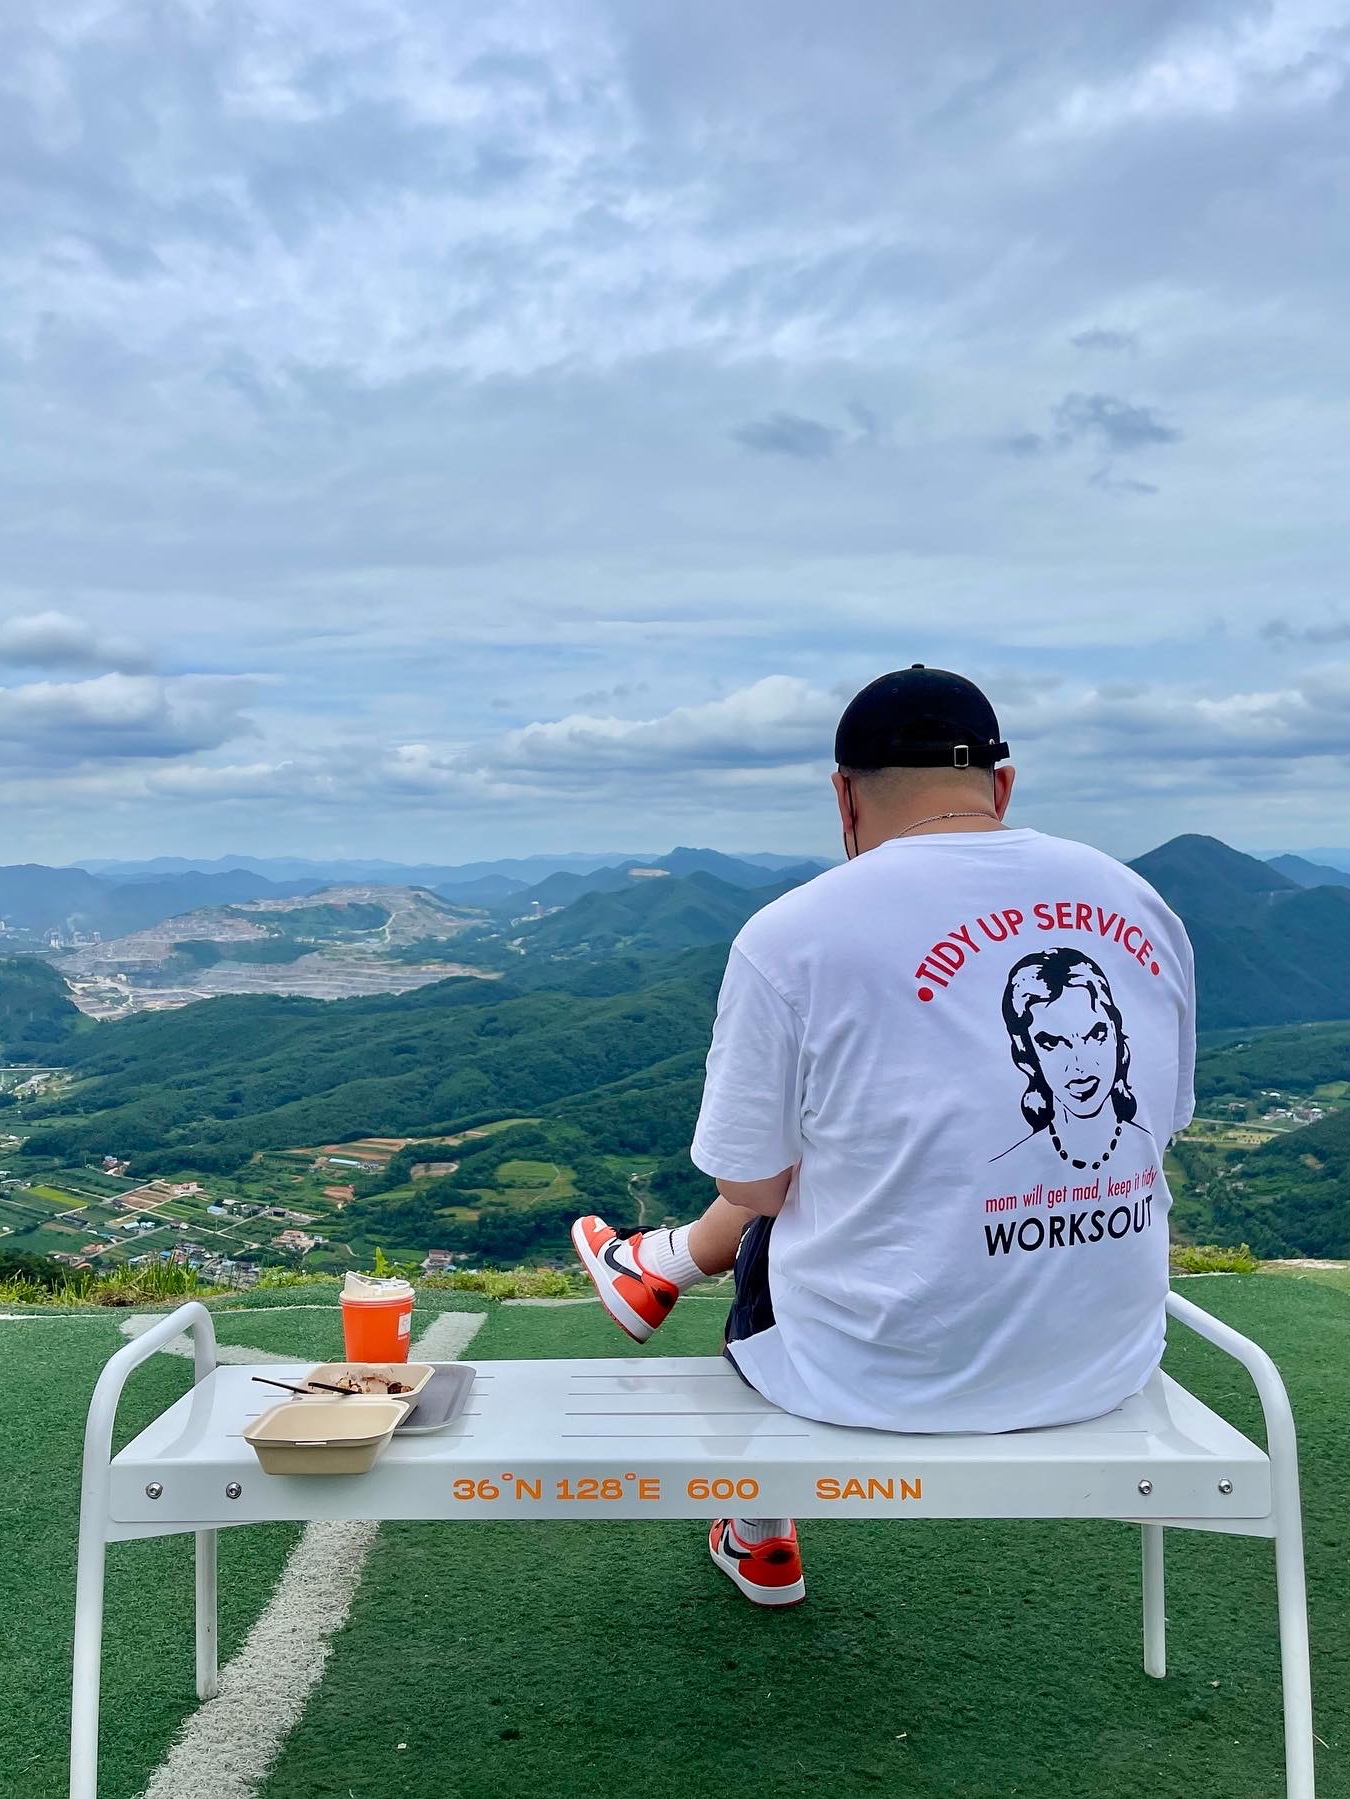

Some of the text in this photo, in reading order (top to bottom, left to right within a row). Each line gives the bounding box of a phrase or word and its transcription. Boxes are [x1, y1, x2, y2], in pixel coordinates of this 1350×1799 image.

[915, 902, 1154, 987] TIDY UP SERVICE
[985, 1165, 1158, 1213] mom will get mad, keep it tidy
[984, 1194, 1153, 1256] WORKSOUT
[453, 1472, 921, 1500] 36°N 128°E 600 SANN
